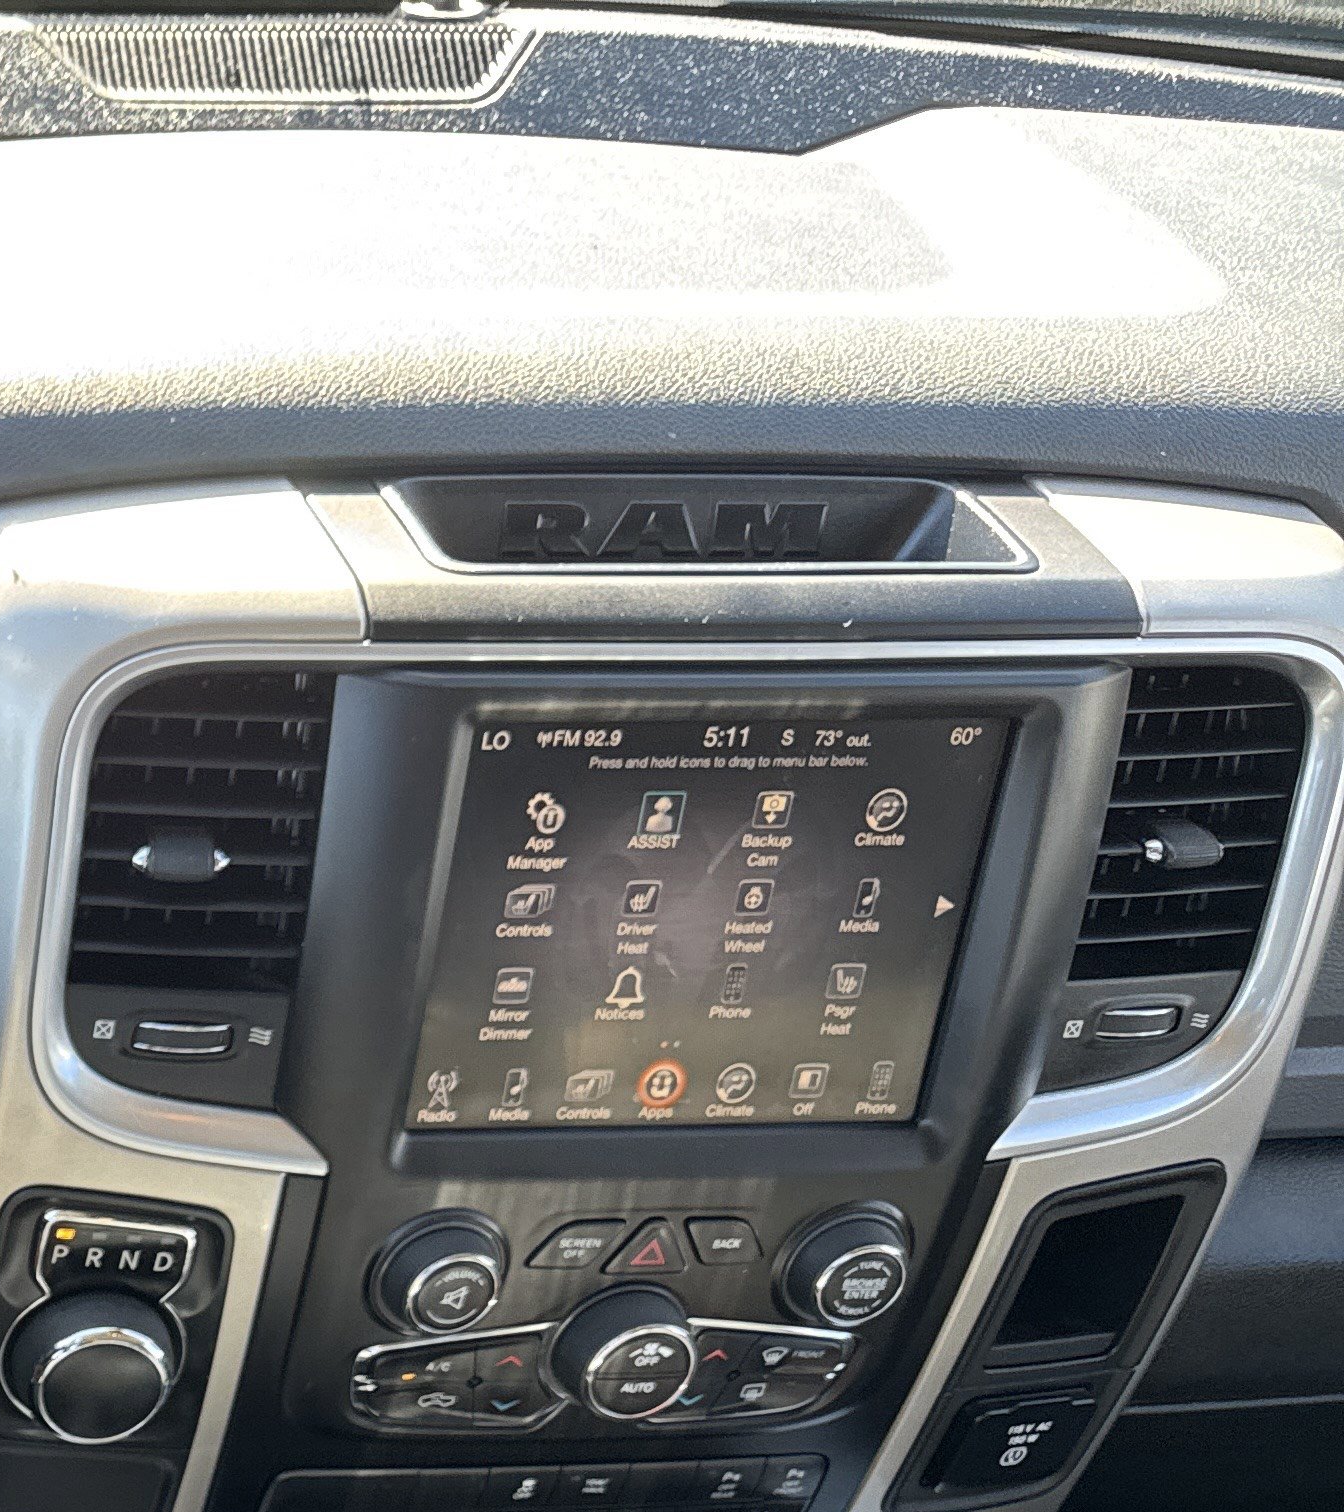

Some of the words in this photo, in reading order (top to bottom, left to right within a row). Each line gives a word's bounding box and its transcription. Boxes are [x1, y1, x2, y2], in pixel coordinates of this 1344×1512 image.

[499, 501, 829, 559] RAM
[480, 730, 511, 750] LO
[553, 729, 582, 748] FM
[584, 728, 623, 747] 92.9
[703, 725, 750, 748] 5:11
[780, 729, 795, 747] S
[814, 729, 843, 747] 73°
[846, 732, 872, 747] out.
[949, 726, 983, 746] 60°
[588, 756, 623, 769] Press
[625, 756, 649, 769] and
[650, 756, 677, 769] hold
[678, 756, 711, 769] icons
[713, 756, 726, 769] to
[727, 756, 756, 770] drag
[758, 756, 771, 768] to
[772, 757, 806, 767] menu
[807, 755, 829, 767] bar
[830, 754, 869, 767] below.
[524, 837, 556, 853] App
[627, 834, 681, 849] ASSIST
[741, 834, 793, 848] Backup
[854, 832, 906, 847] Climate
[506, 856, 568, 872] Manager
[746, 853, 780, 867] Cam
[495, 923, 554, 938] Controls
[616, 922, 657, 936] Driver
[724, 920, 774, 935] Heated
[838, 919, 881, 933] Media
[616, 941, 649, 955] Heat
[724, 939, 766, 954] Wheel
[488, 1008, 531, 1023] Mirror
[594, 1007, 646, 1021] Notices
[708, 1006, 752, 1020] Phone
[824, 1004, 857, 1019] Psgr
[478, 1027, 534, 1042] Dimmer
[819, 1023, 853, 1036] Heat
[416, 1108, 459, 1123] Radio
[488, 1107, 532, 1122] Media
[555, 1106, 612, 1121] Controls
[637, 1107, 675, 1122] Apps
[704, 1105, 755, 1118] Climate
[792, 1102, 816, 1116] Off
[854, 1102, 897, 1115] Phone
[559, 1238, 602, 1249] SCREEN
[712, 1238, 743, 1250] BACK
[51, 1247, 70, 1265] P
[84, 1248, 105, 1269] R
[118, 1250, 141, 1271] N
[152, 1252, 176, 1273] D
[425, 1361, 452, 1373] A/C
[620, 1381, 657, 1394] AUTO
